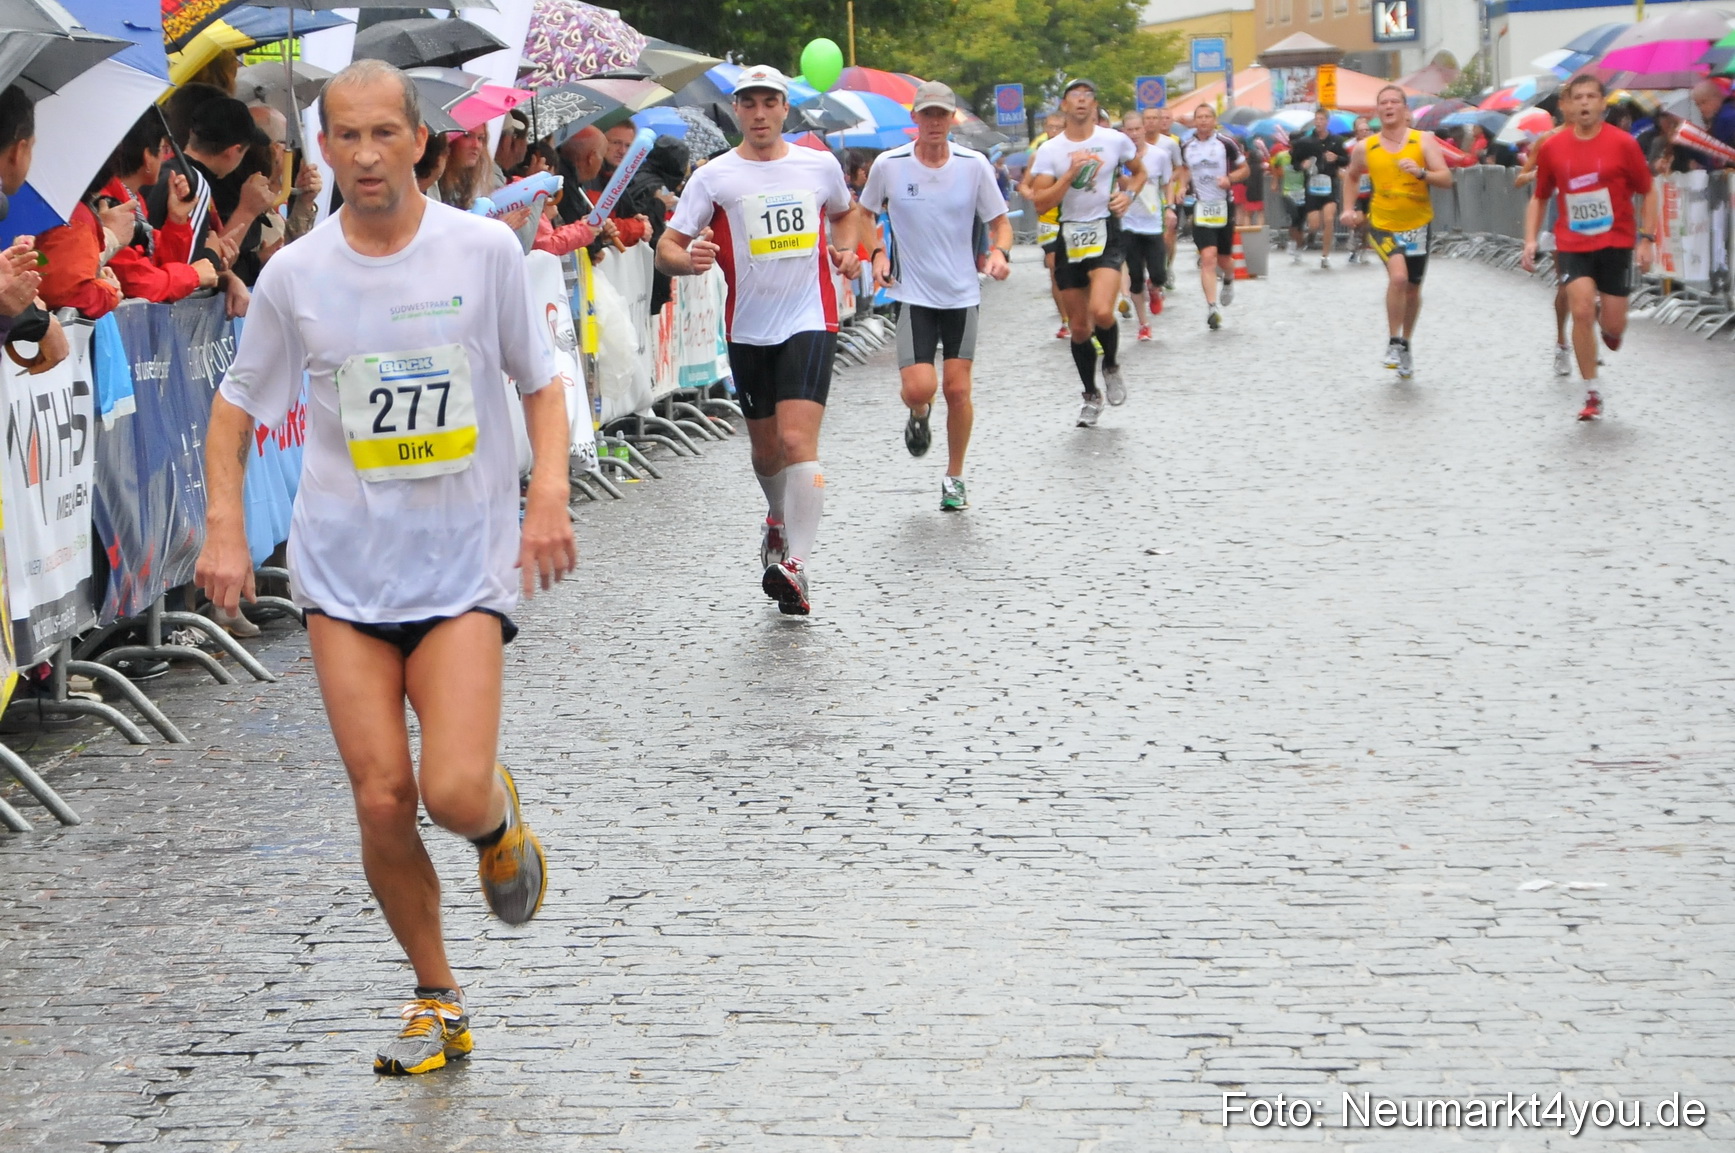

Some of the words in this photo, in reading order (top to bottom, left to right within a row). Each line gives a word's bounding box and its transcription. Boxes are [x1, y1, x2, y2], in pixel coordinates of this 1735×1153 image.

[999, 112, 1022, 121] TAXI
[601, 196, 614, 210] TUI
[611, 147, 648, 199] ReiseCenter
[1571, 201, 1608, 220] 2035
[760, 207, 805, 235] 168
[770, 237, 800, 250] Daniel
[1071, 232, 1098, 247] 822
[389, 300, 450, 315] SÜDWESTPARK
[379, 356, 434, 374] BOCK
[369, 380, 452, 435] 277
[398, 440, 435, 461] Dirk
